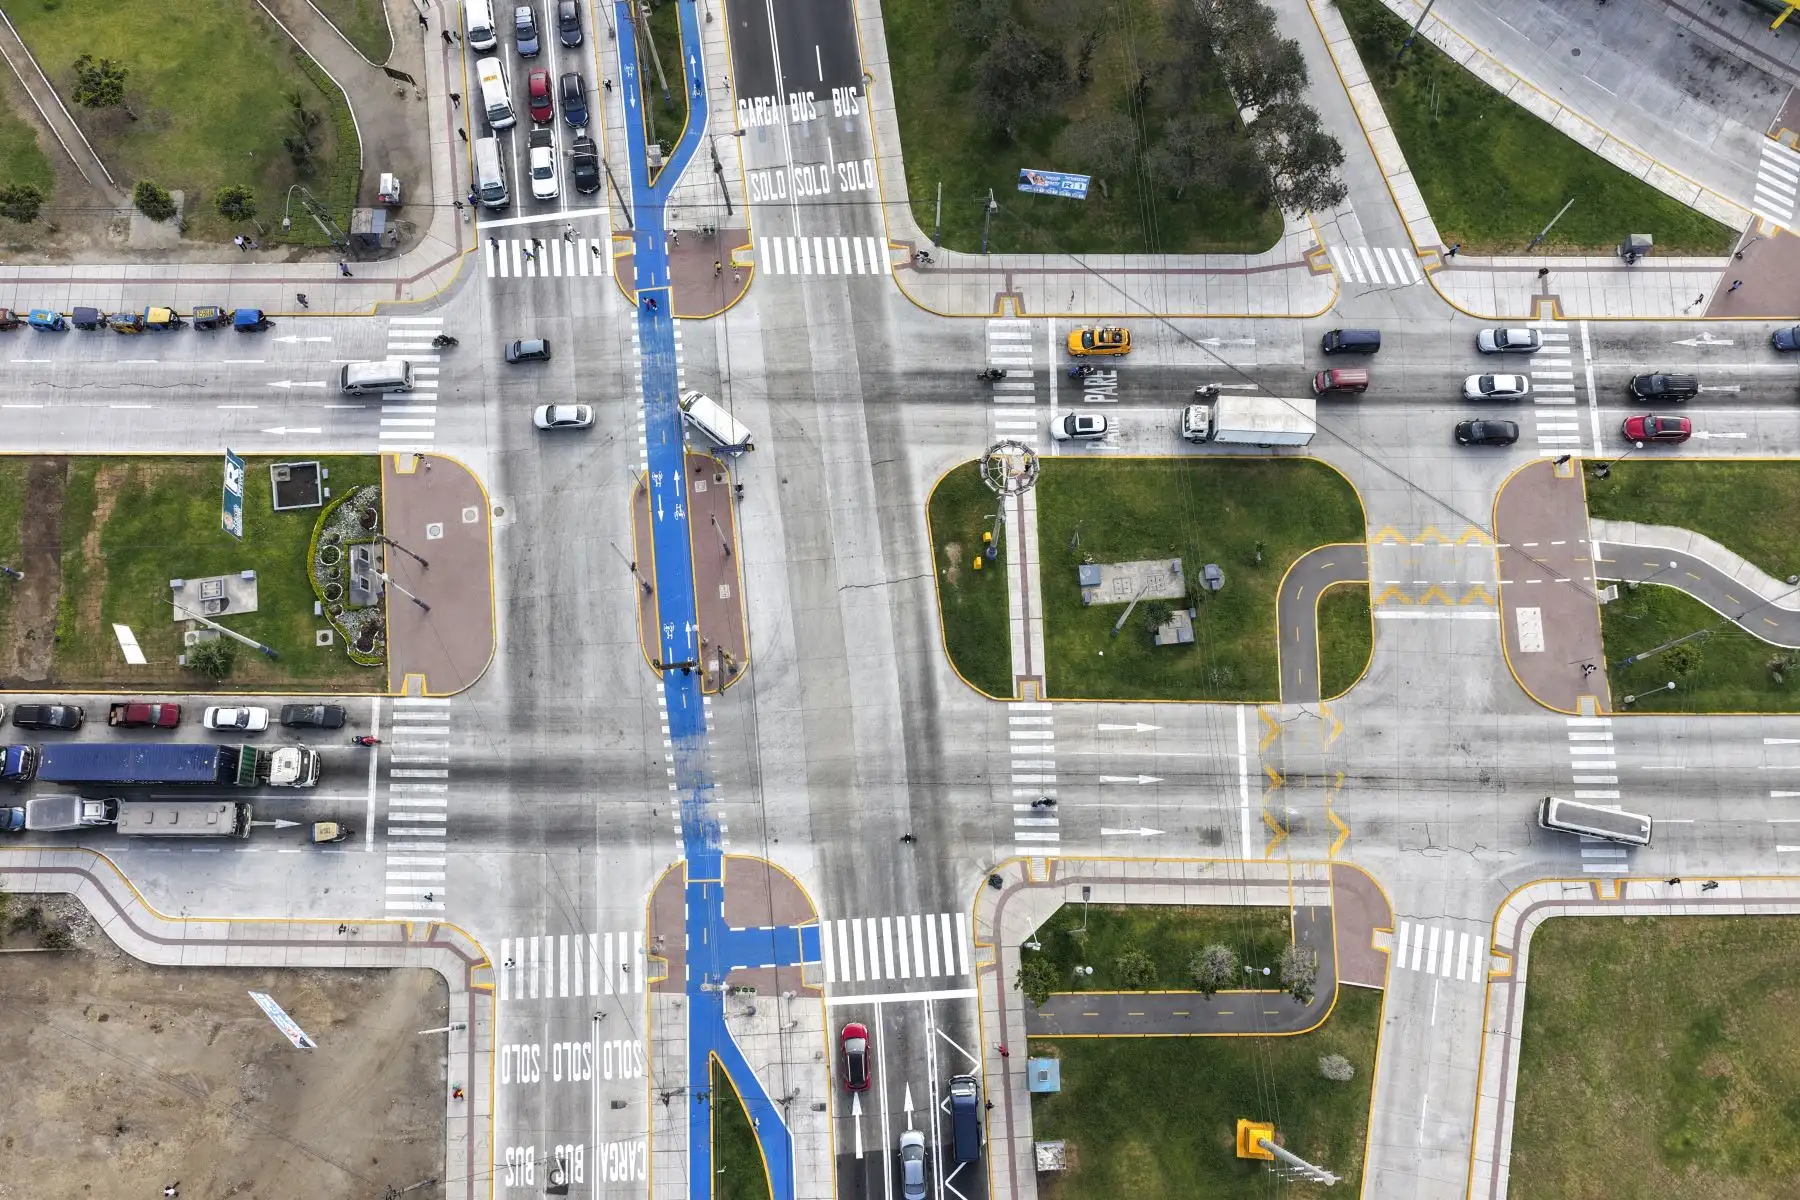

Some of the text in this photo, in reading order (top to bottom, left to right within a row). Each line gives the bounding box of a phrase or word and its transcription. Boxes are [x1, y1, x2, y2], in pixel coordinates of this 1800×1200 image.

[739, 95, 780, 127] CARGA
[789, 91, 816, 122] BUS
[832, 86, 859, 118] BUS
[751, 170, 786, 201] SOLO
[794, 165, 830, 196] SOLO
[838, 159, 873, 192] SOLO
[1083, 370, 1118, 402] PARE
[501, 1044, 540, 1085] SOLO
[553, 1041, 591, 1082] SOLO
[603, 1039, 642, 1080] SOLO
[505, 1144, 534, 1187] BUS
[555, 1144, 584, 1185] BUS
[600, 1141, 646, 1183] CARGA
